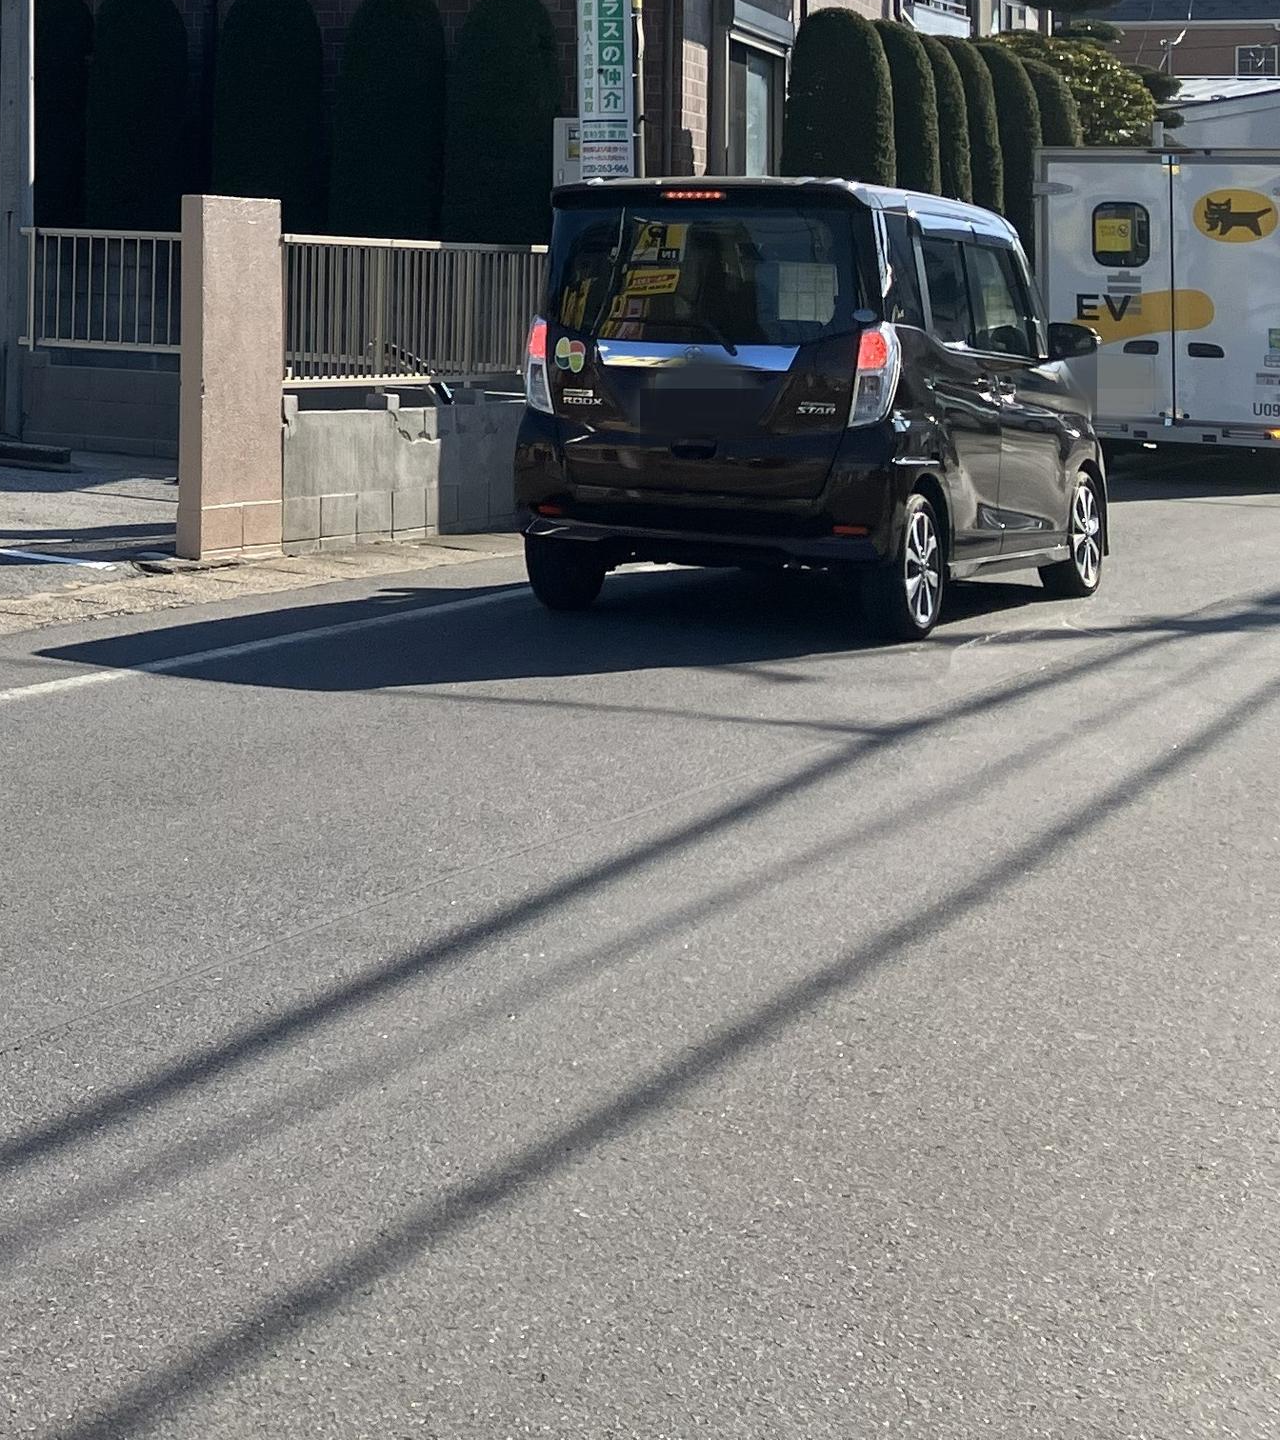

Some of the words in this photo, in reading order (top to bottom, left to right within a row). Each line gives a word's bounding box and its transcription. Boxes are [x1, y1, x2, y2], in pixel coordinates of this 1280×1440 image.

[1076, 293, 1132, 321] EV
[563, 397, 602, 405] ROOX
[796, 406, 836, 414] STAR
